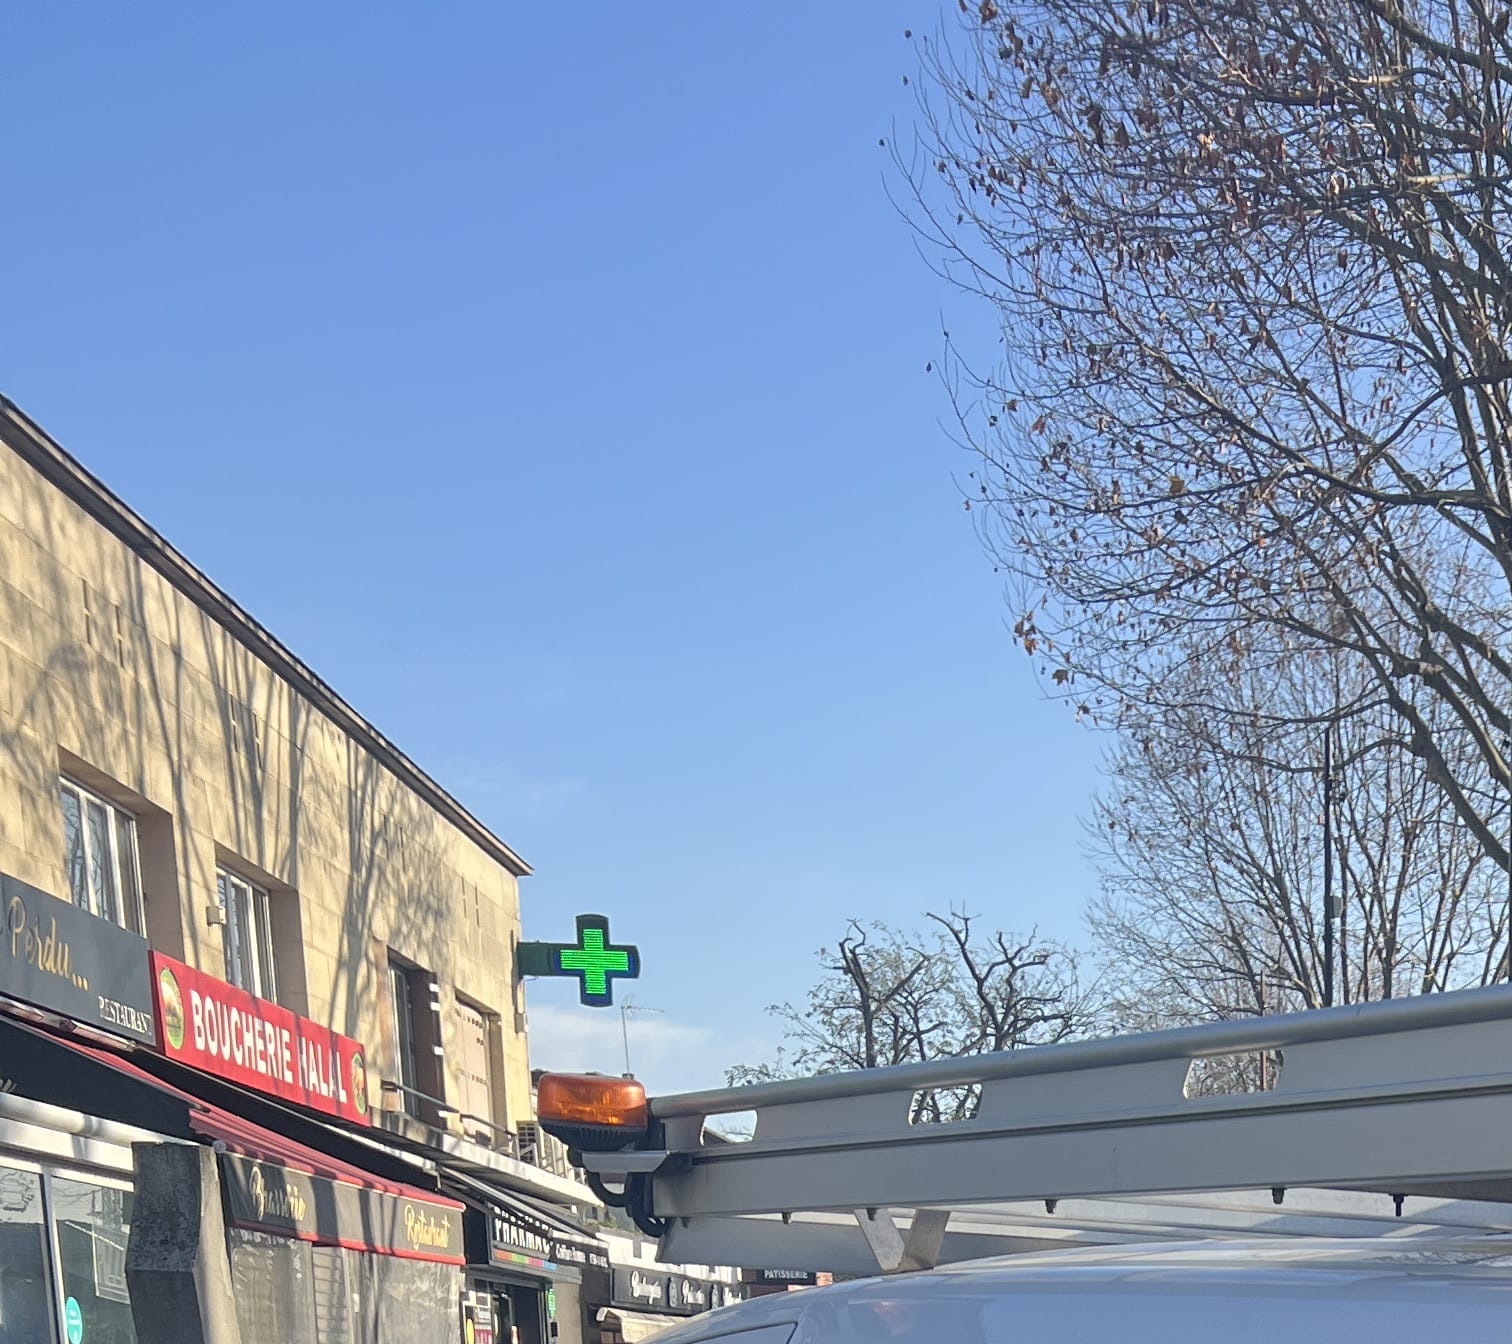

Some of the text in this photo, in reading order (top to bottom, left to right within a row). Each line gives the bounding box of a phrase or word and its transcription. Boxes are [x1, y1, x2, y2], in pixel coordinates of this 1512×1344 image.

[98, 995, 152, 1034] RESTAURANT
[190, 989, 347, 1103] BOUCHERIE HALAL
[404, 1204, 450, 1250] Restaurant
[495, 1218, 552, 1254] PHARMAC
